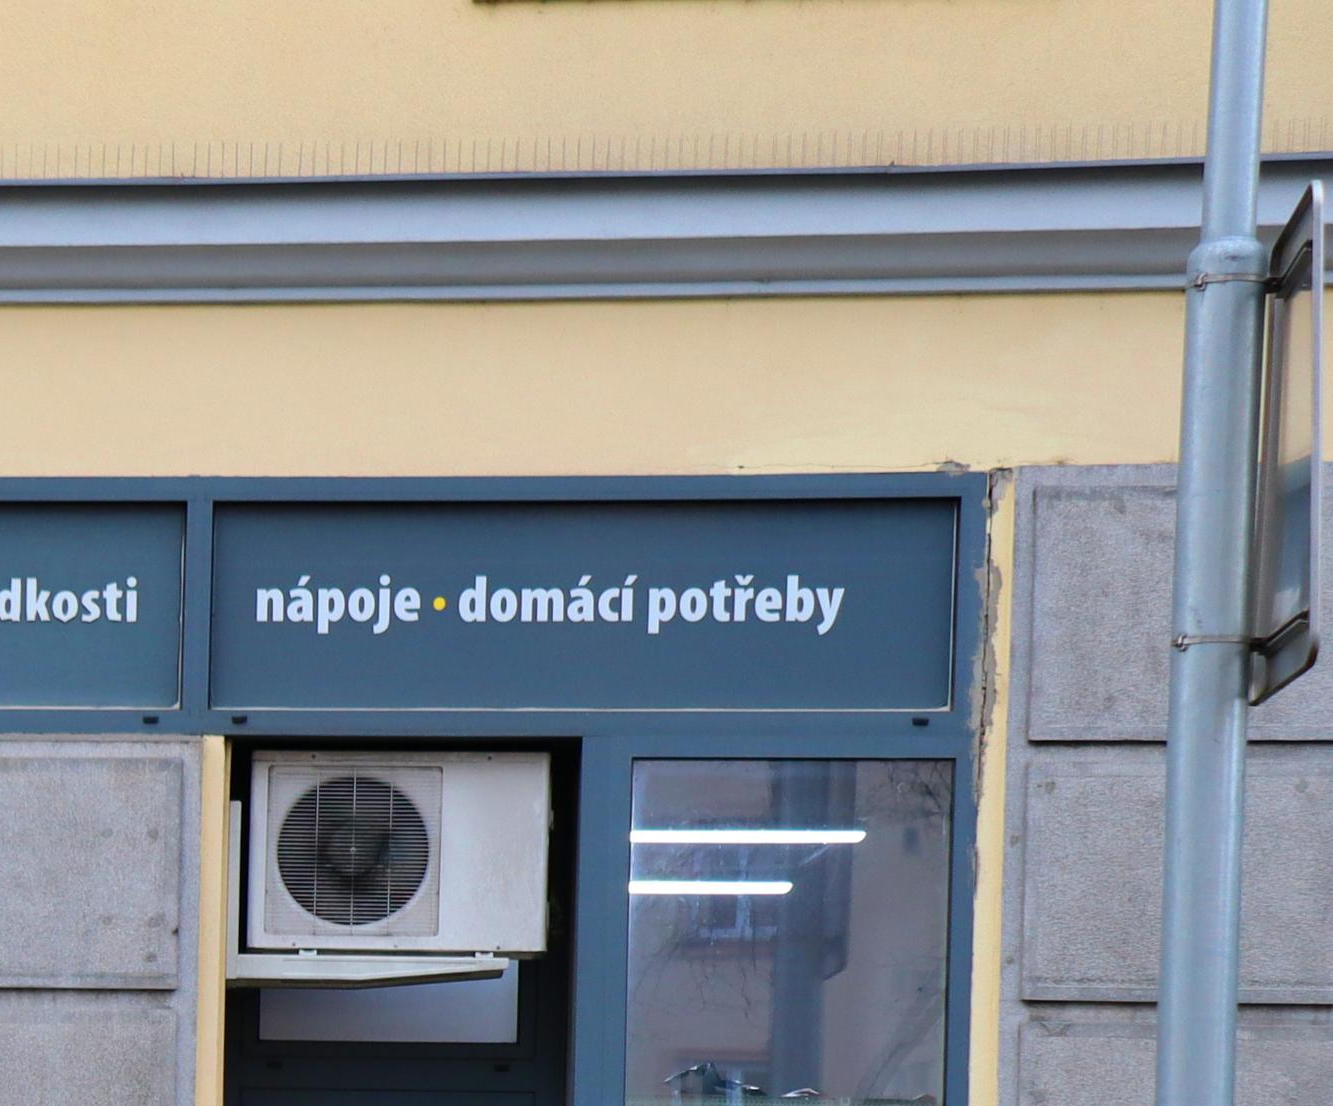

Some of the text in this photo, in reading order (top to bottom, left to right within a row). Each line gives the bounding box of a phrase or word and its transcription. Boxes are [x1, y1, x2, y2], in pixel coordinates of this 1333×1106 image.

[255, 575, 846, 635] nápoje domácí potřeby
